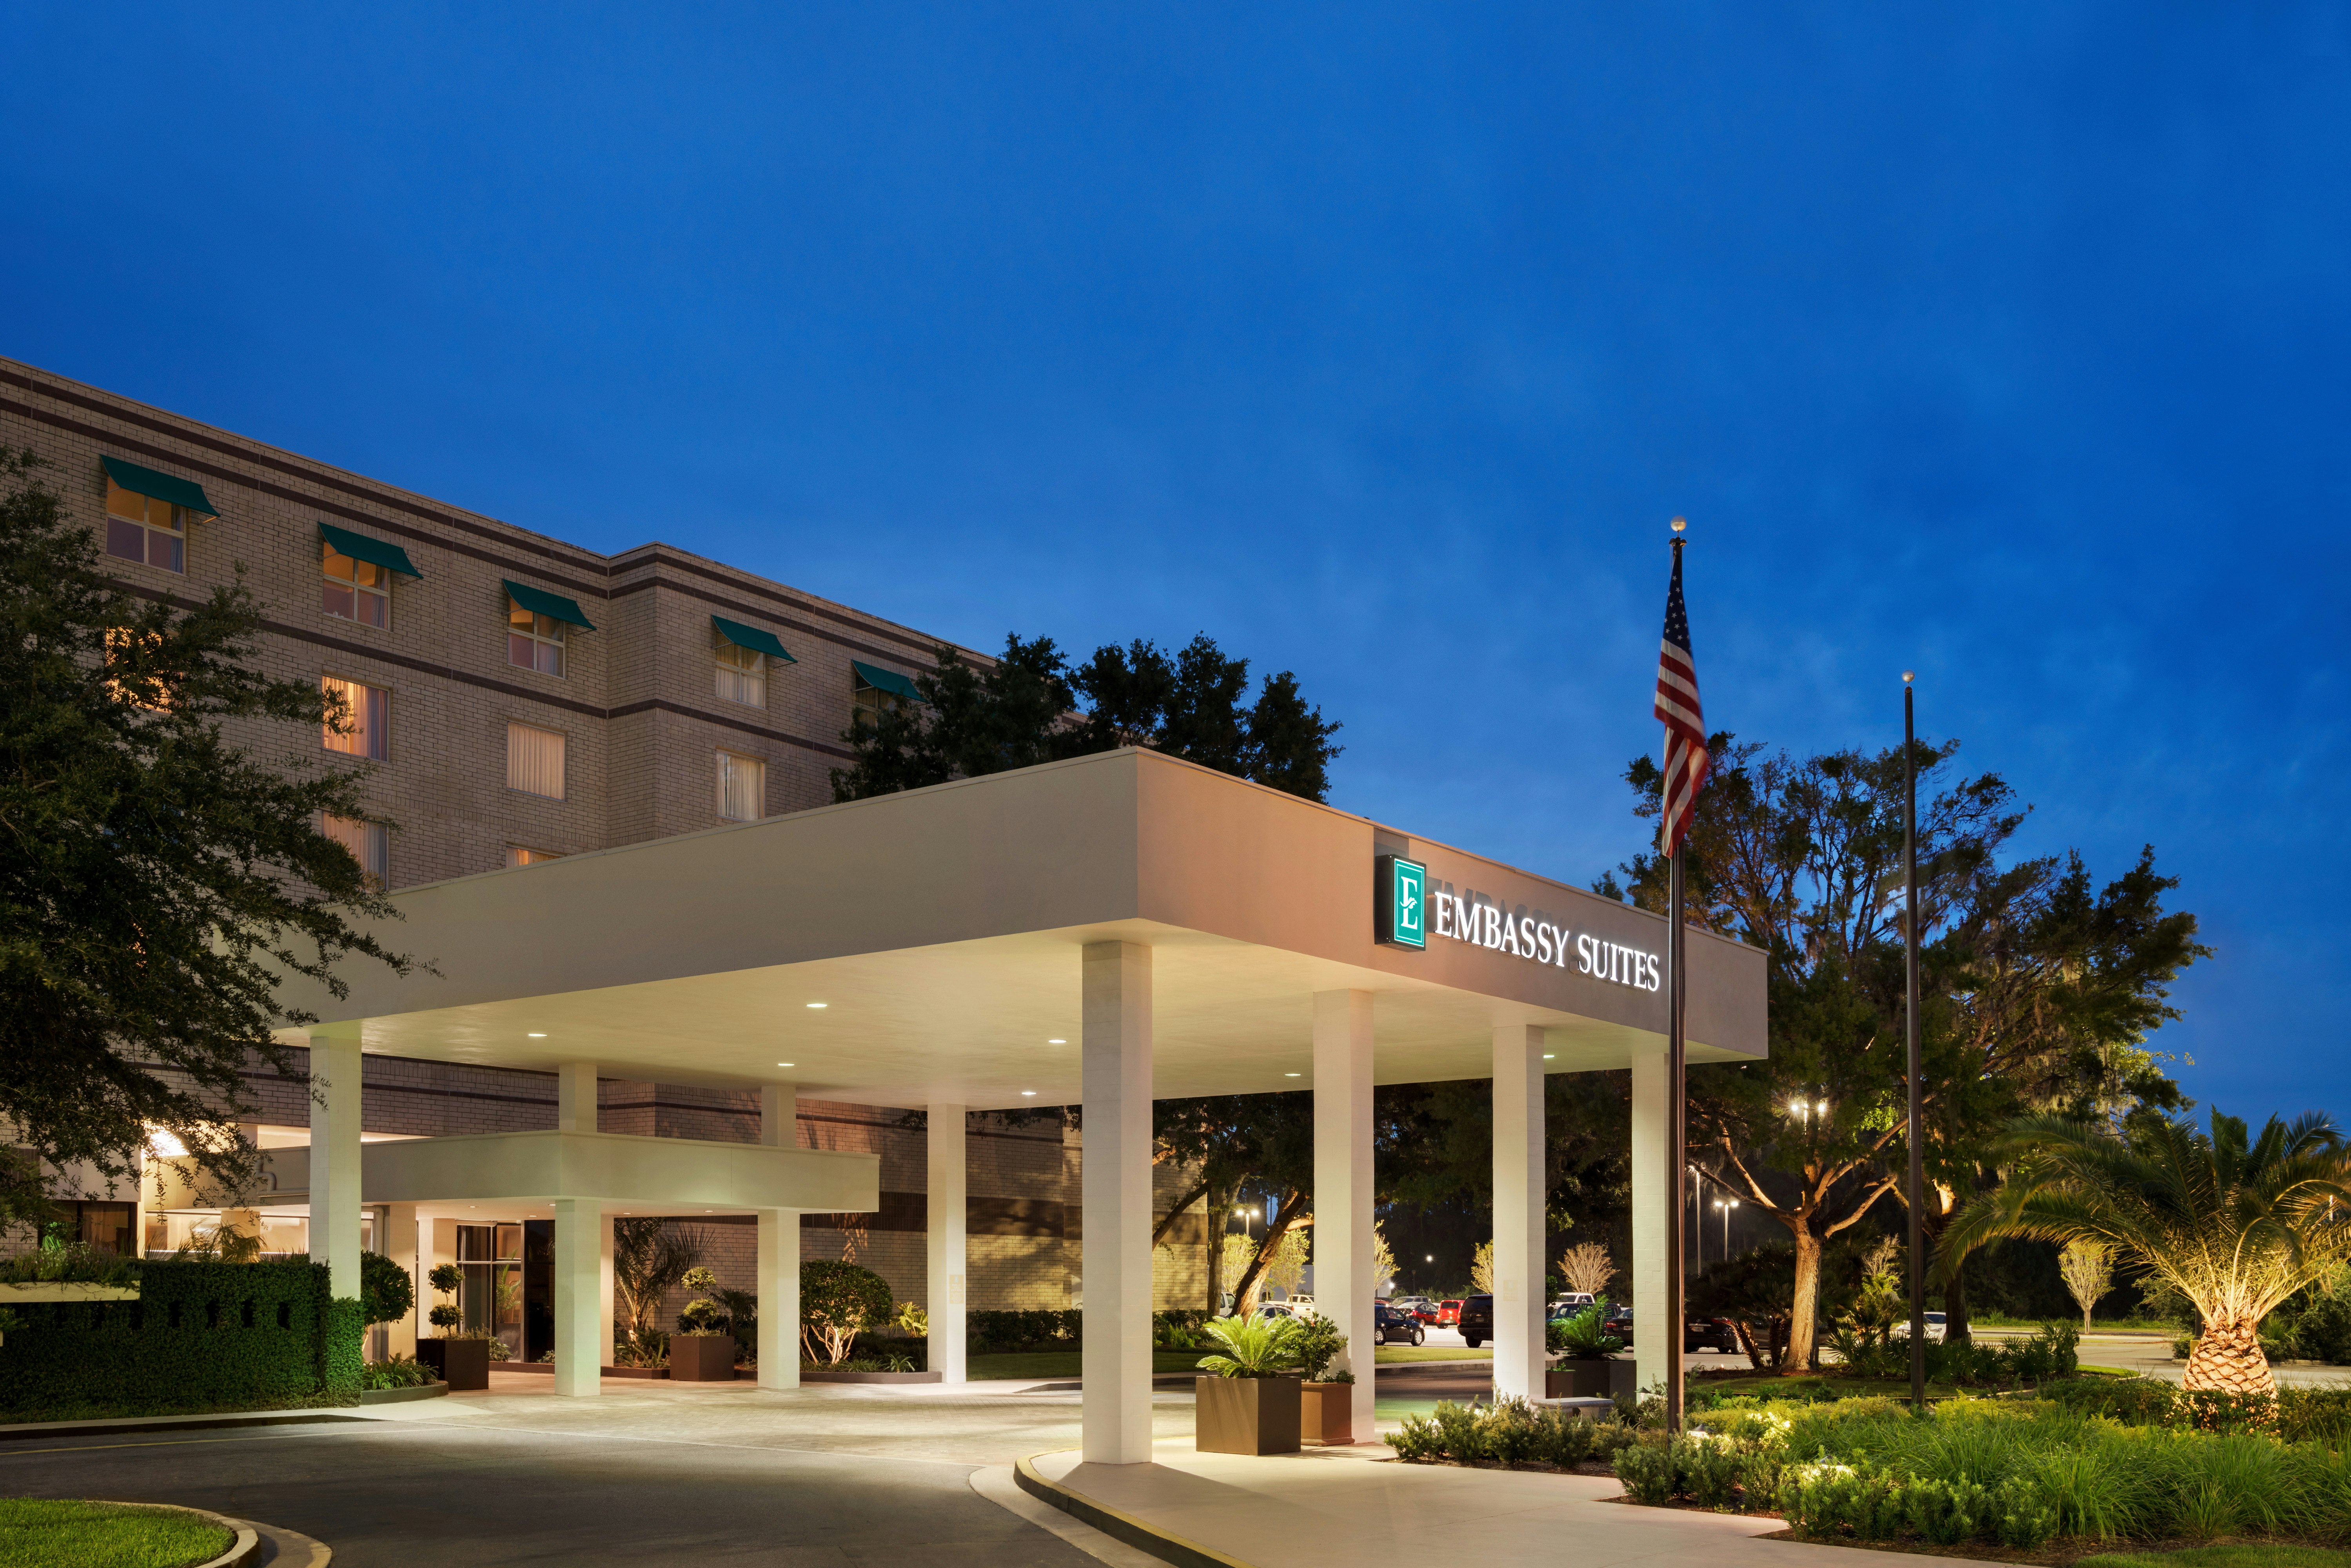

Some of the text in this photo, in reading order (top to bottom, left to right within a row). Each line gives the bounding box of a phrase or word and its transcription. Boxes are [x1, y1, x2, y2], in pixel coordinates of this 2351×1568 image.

[1400, 876, 1418, 930] E
[1434, 891, 1659, 992] EMBASSY SUITES
